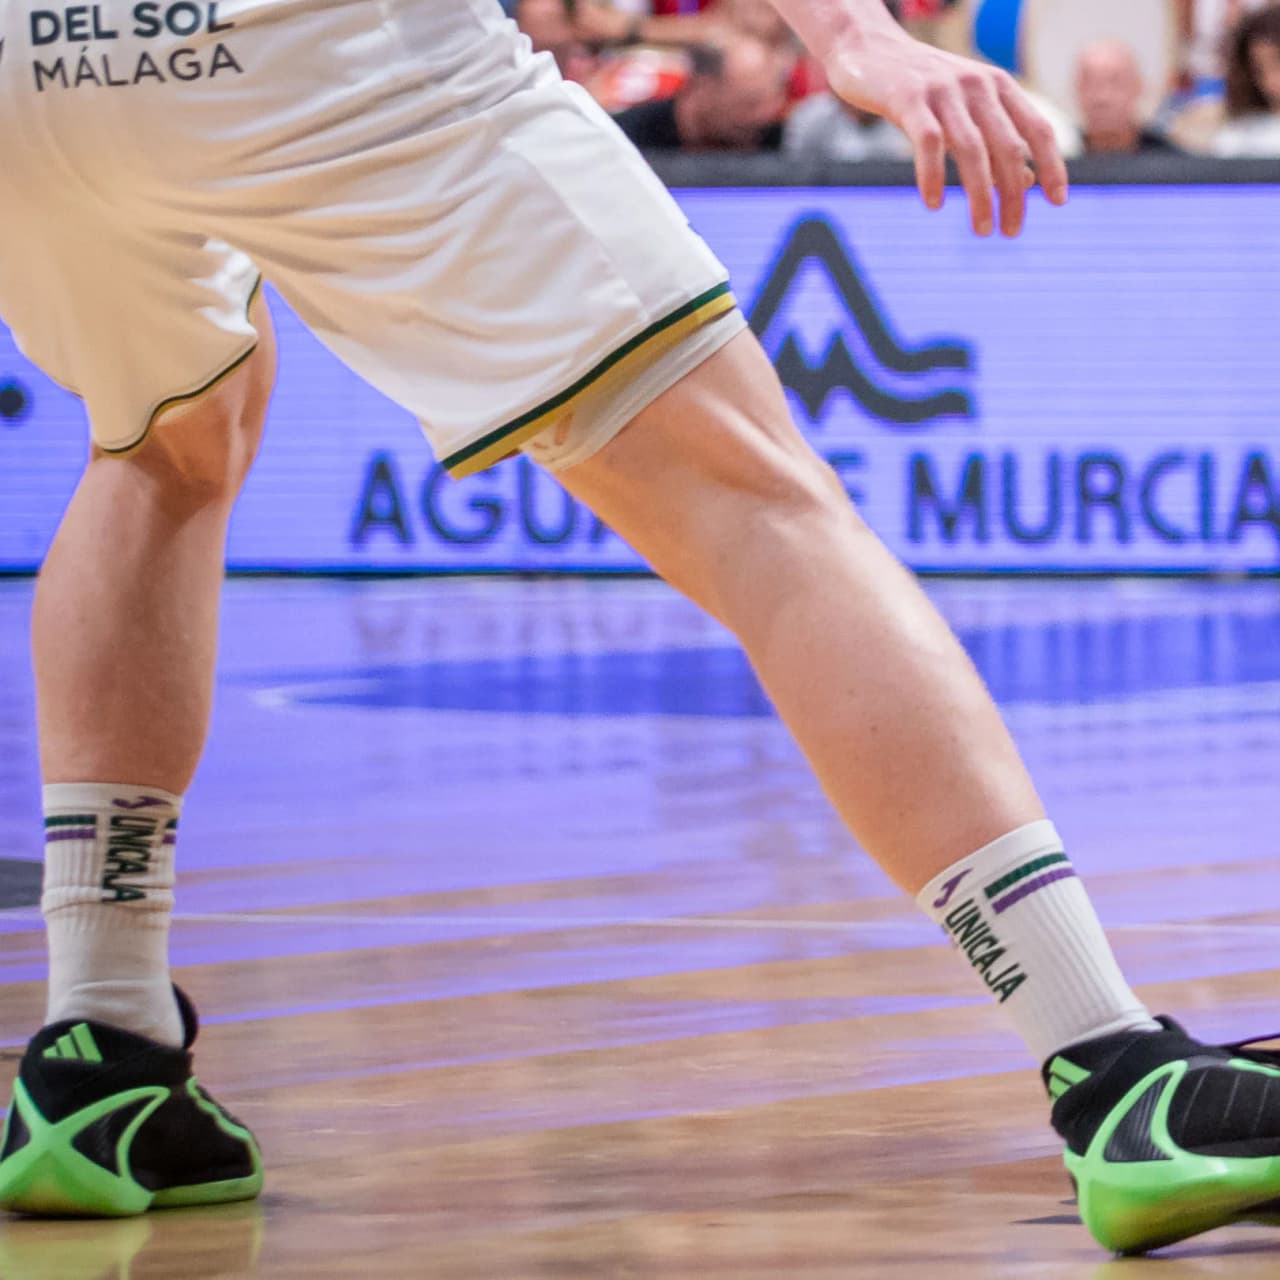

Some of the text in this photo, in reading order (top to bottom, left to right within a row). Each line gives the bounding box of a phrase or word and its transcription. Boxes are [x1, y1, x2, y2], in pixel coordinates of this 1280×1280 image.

[29, 1, 236, 47] DEL SOL
[33, 43, 244, 92] MÁLAGA
[350, 450, 620, 547] AGU
[102, 815, 158, 904] UNICAJA
[945, 897, 1028, 1004] UNICAJA
